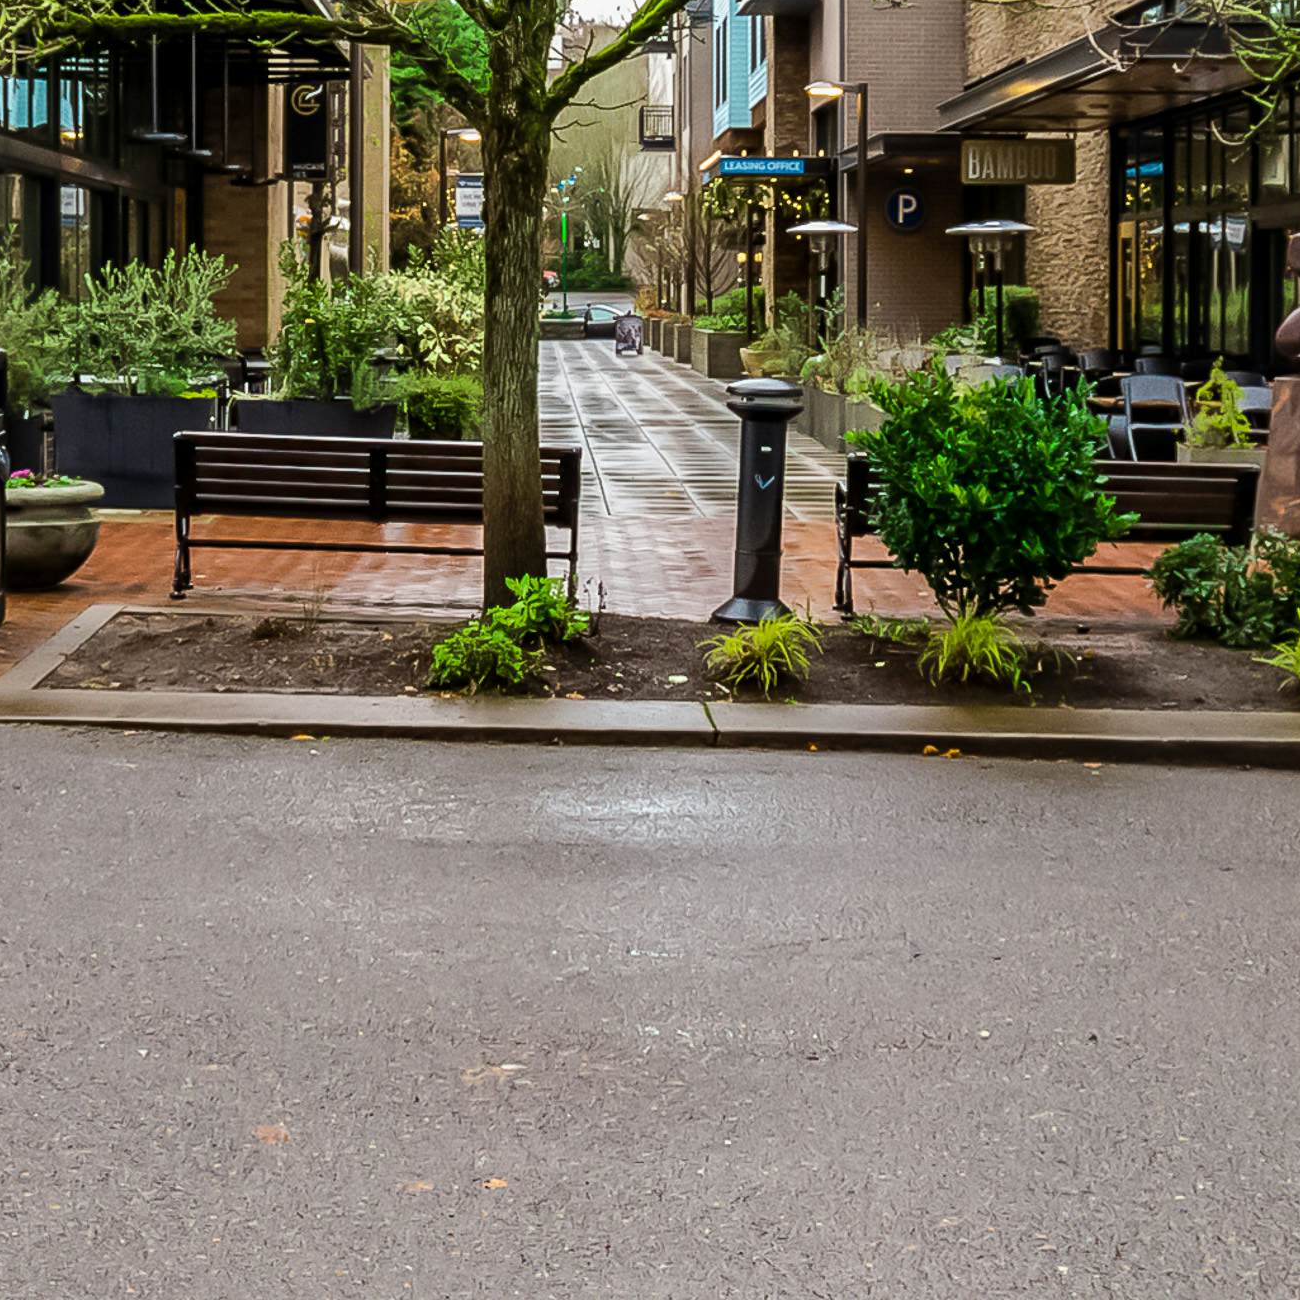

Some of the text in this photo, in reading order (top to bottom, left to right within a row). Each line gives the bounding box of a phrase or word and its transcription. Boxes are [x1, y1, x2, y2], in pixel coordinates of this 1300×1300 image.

[724, 161, 800, 171] LEASING OFFICE
[968, 145, 1057, 180] BAMBOO
[897, 194, 917, 224] P
